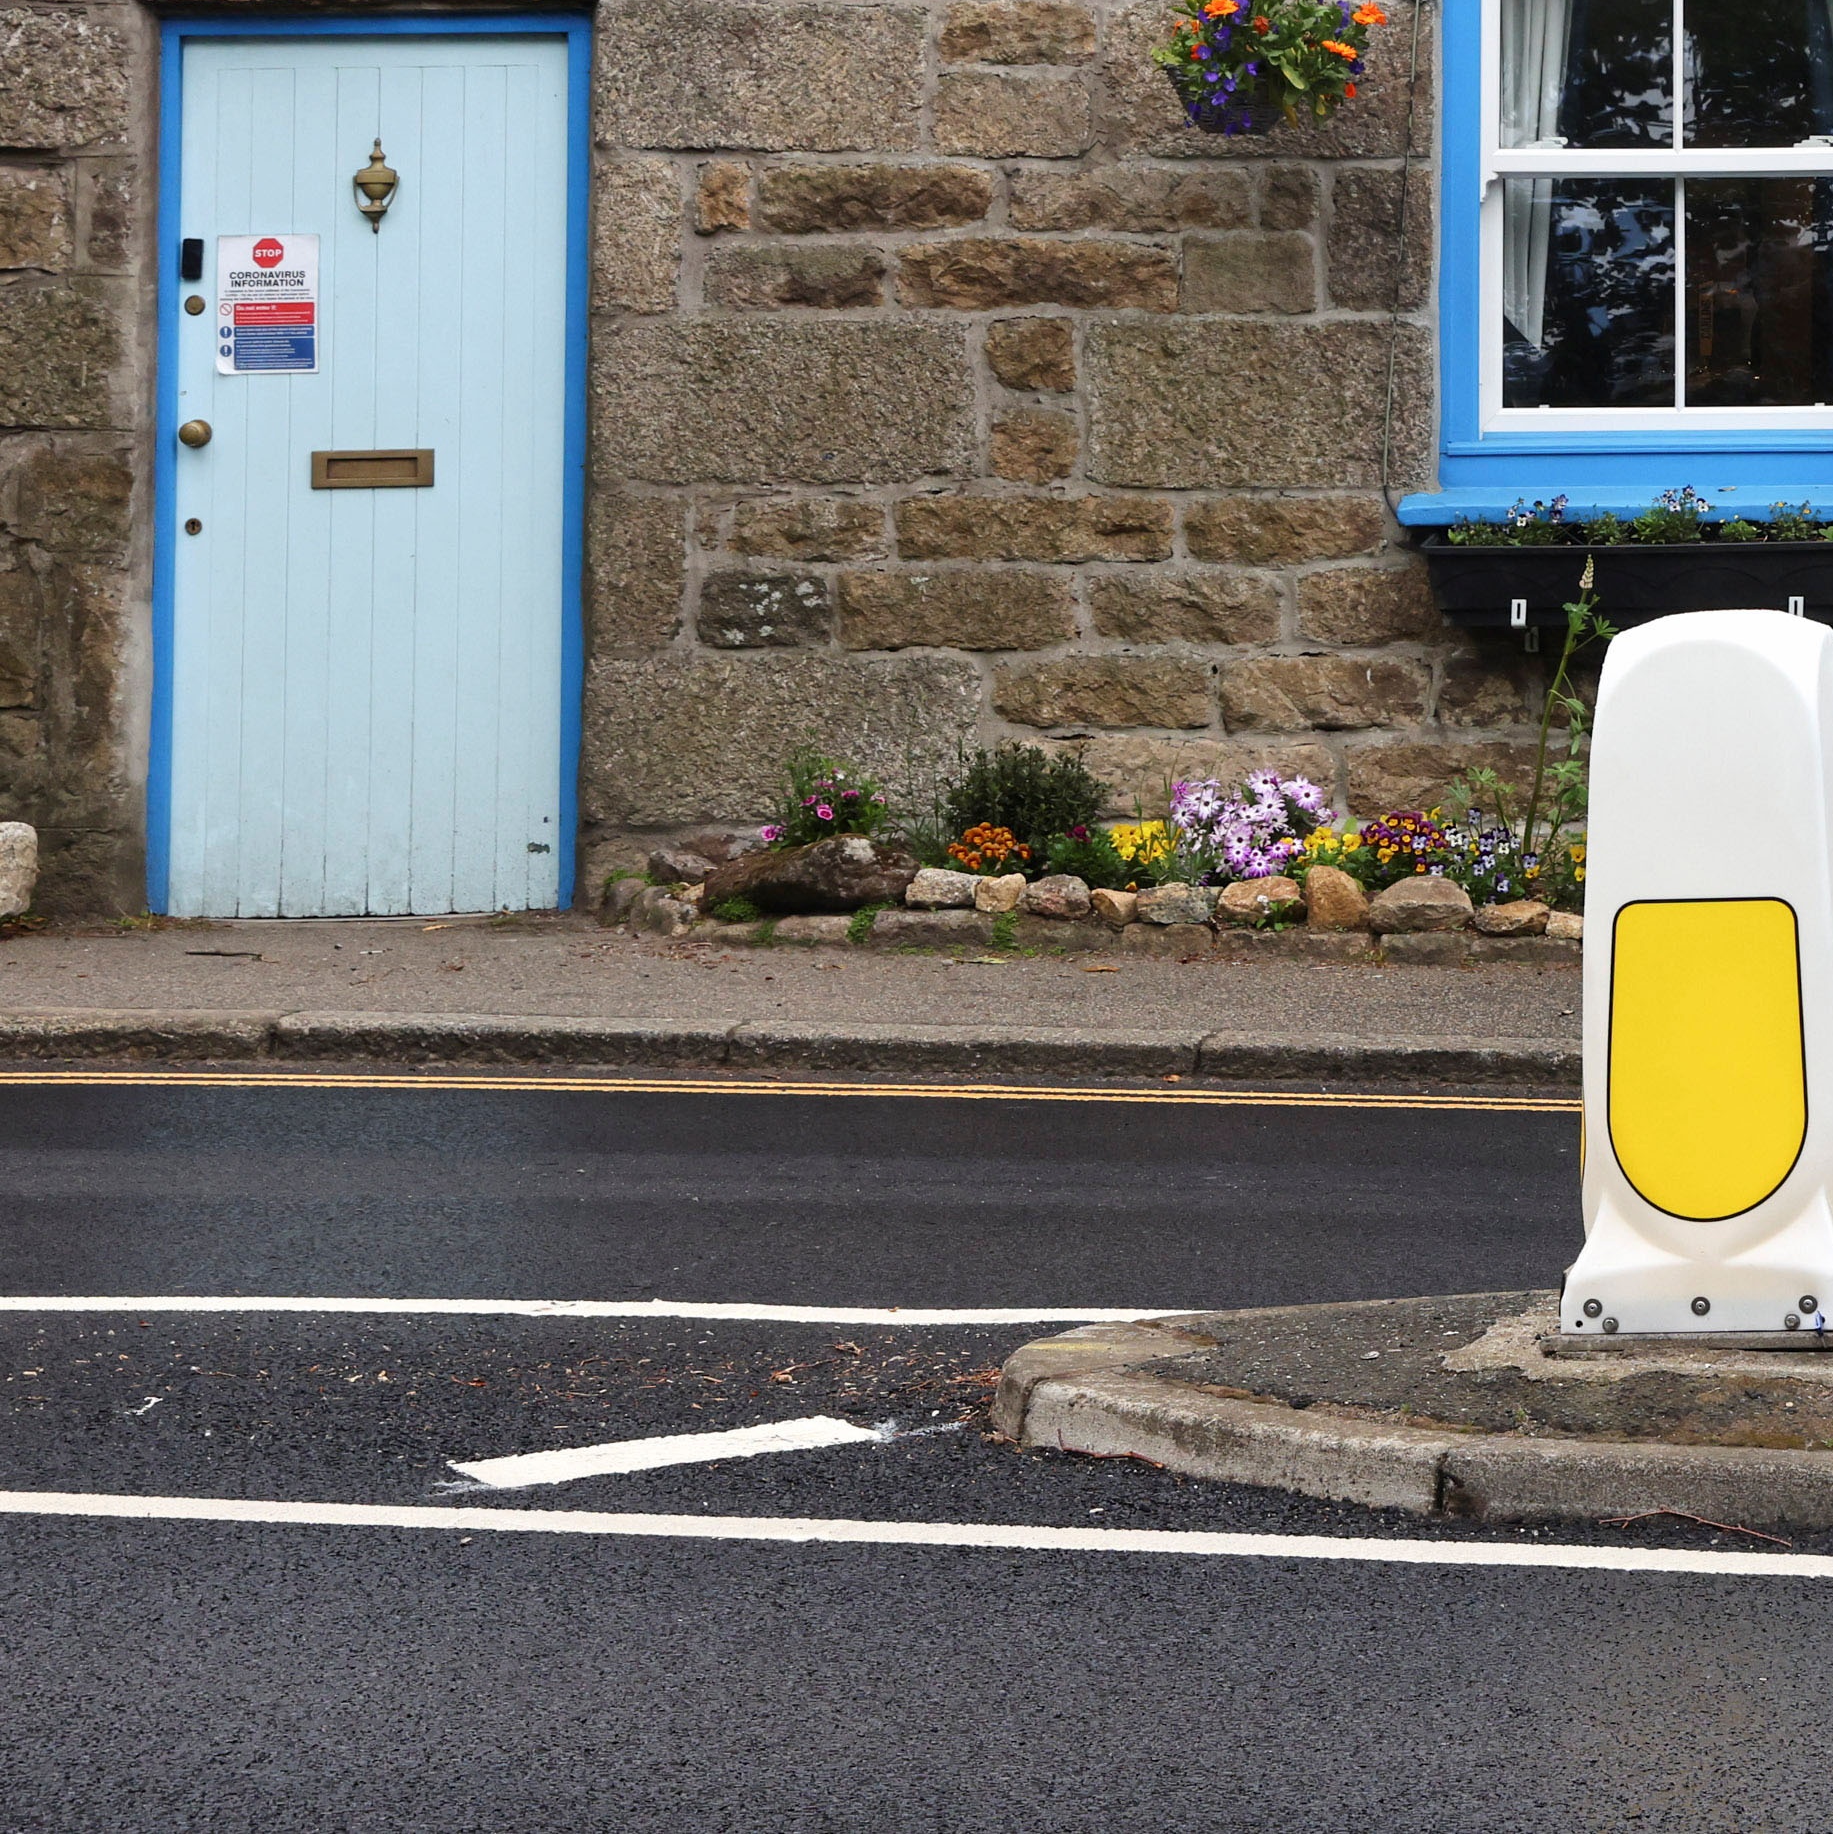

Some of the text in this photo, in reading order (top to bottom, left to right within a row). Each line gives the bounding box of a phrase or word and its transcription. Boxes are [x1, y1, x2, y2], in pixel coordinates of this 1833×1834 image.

[255, 249, 282, 257] STOP
[229, 271, 306, 279] CORONAVIRUS
[231, 279, 304, 287] INFORMATION
